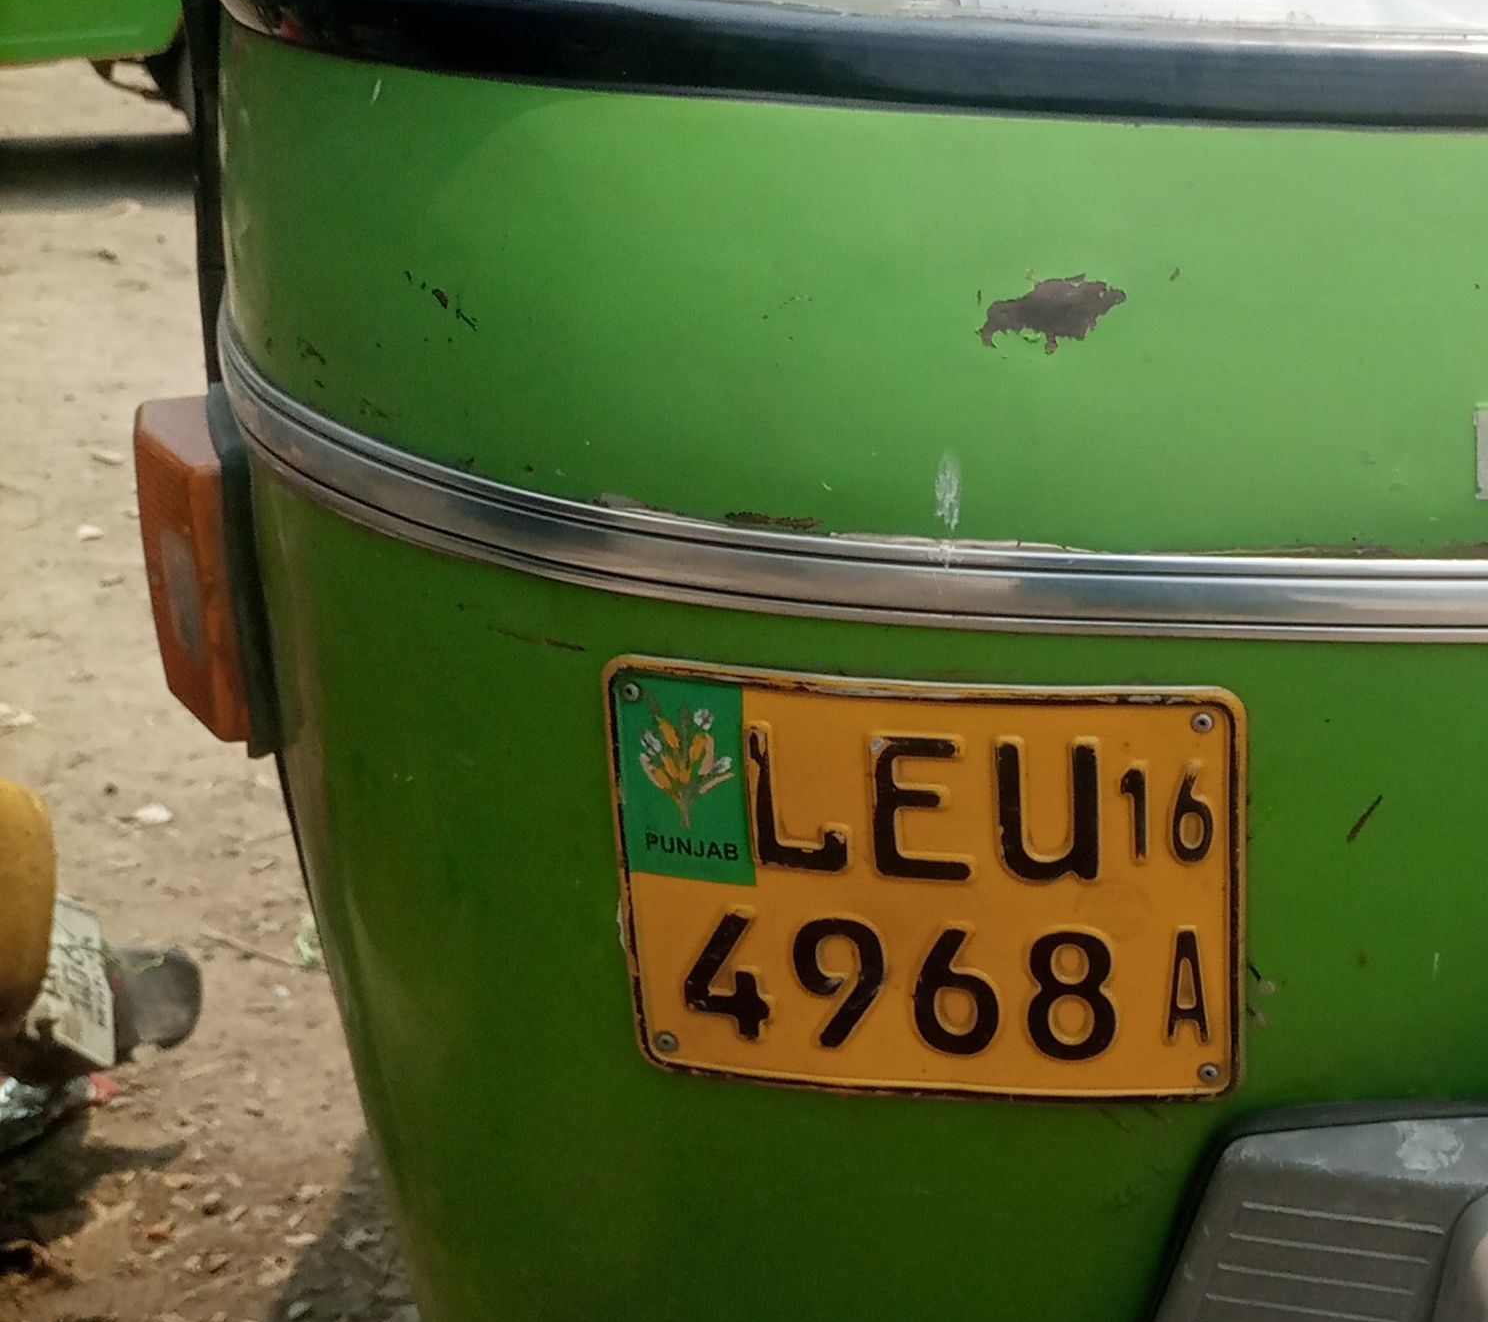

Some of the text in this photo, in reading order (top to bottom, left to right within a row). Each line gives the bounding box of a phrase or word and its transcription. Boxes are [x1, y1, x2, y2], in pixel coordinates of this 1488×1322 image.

[645, 831, 739, 861] PUNJAB
[748, 722, 1214, 883] LEU 16
[682, 906, 1211, 1063] 4968 A
